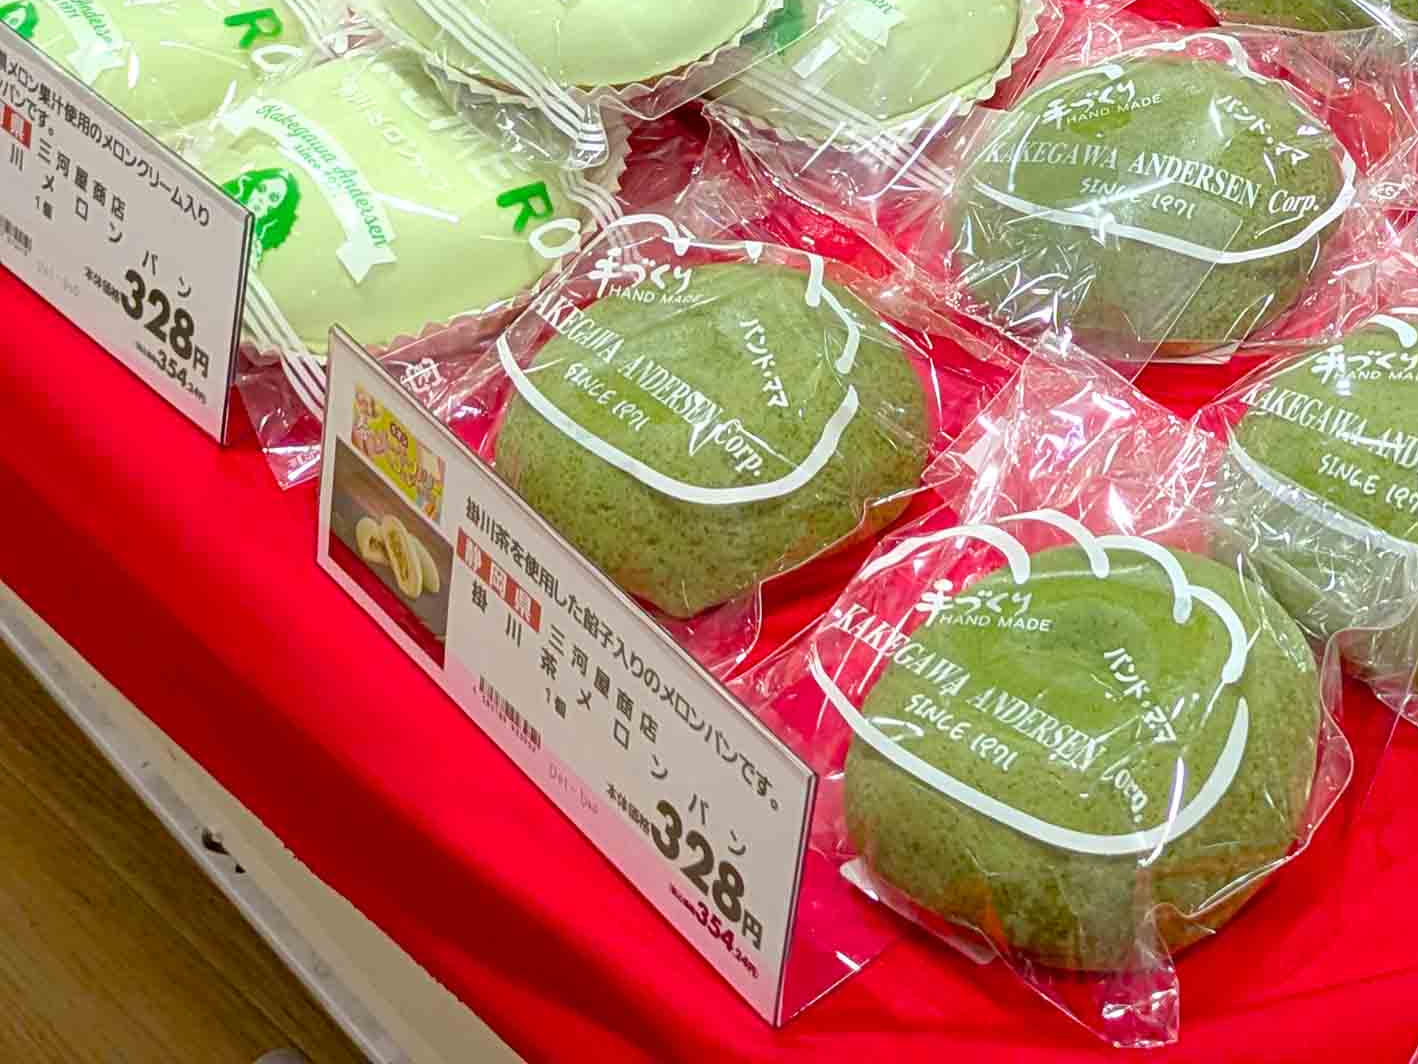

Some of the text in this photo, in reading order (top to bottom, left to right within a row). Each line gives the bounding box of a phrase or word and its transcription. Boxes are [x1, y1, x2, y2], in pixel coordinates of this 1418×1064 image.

[1065, 93, 1162, 124] HAND MADE
[335, 162, 390, 250] Andersen
[1127, 150, 1264, 210] ANDERSEN
[1267, 189, 1320, 217] Corp.
[121, 268, 210, 379] 328円
[608, 285, 656, 304] HAND
[564, 362, 614, 406] SINCE
[622, 356, 722, 435] ANDERSEN
[713, 417, 763, 478] Corp.
[1320, 453, 1377, 496] SINCE
[938, 612, 1053, 633] HAND MADE
[549, 623, 659, 744] 三河屋商店
[904, 692, 969, 741] SINCE
[967, 687, 1106, 774] ANDERSEN
[650, 799, 764, 951] 328円
